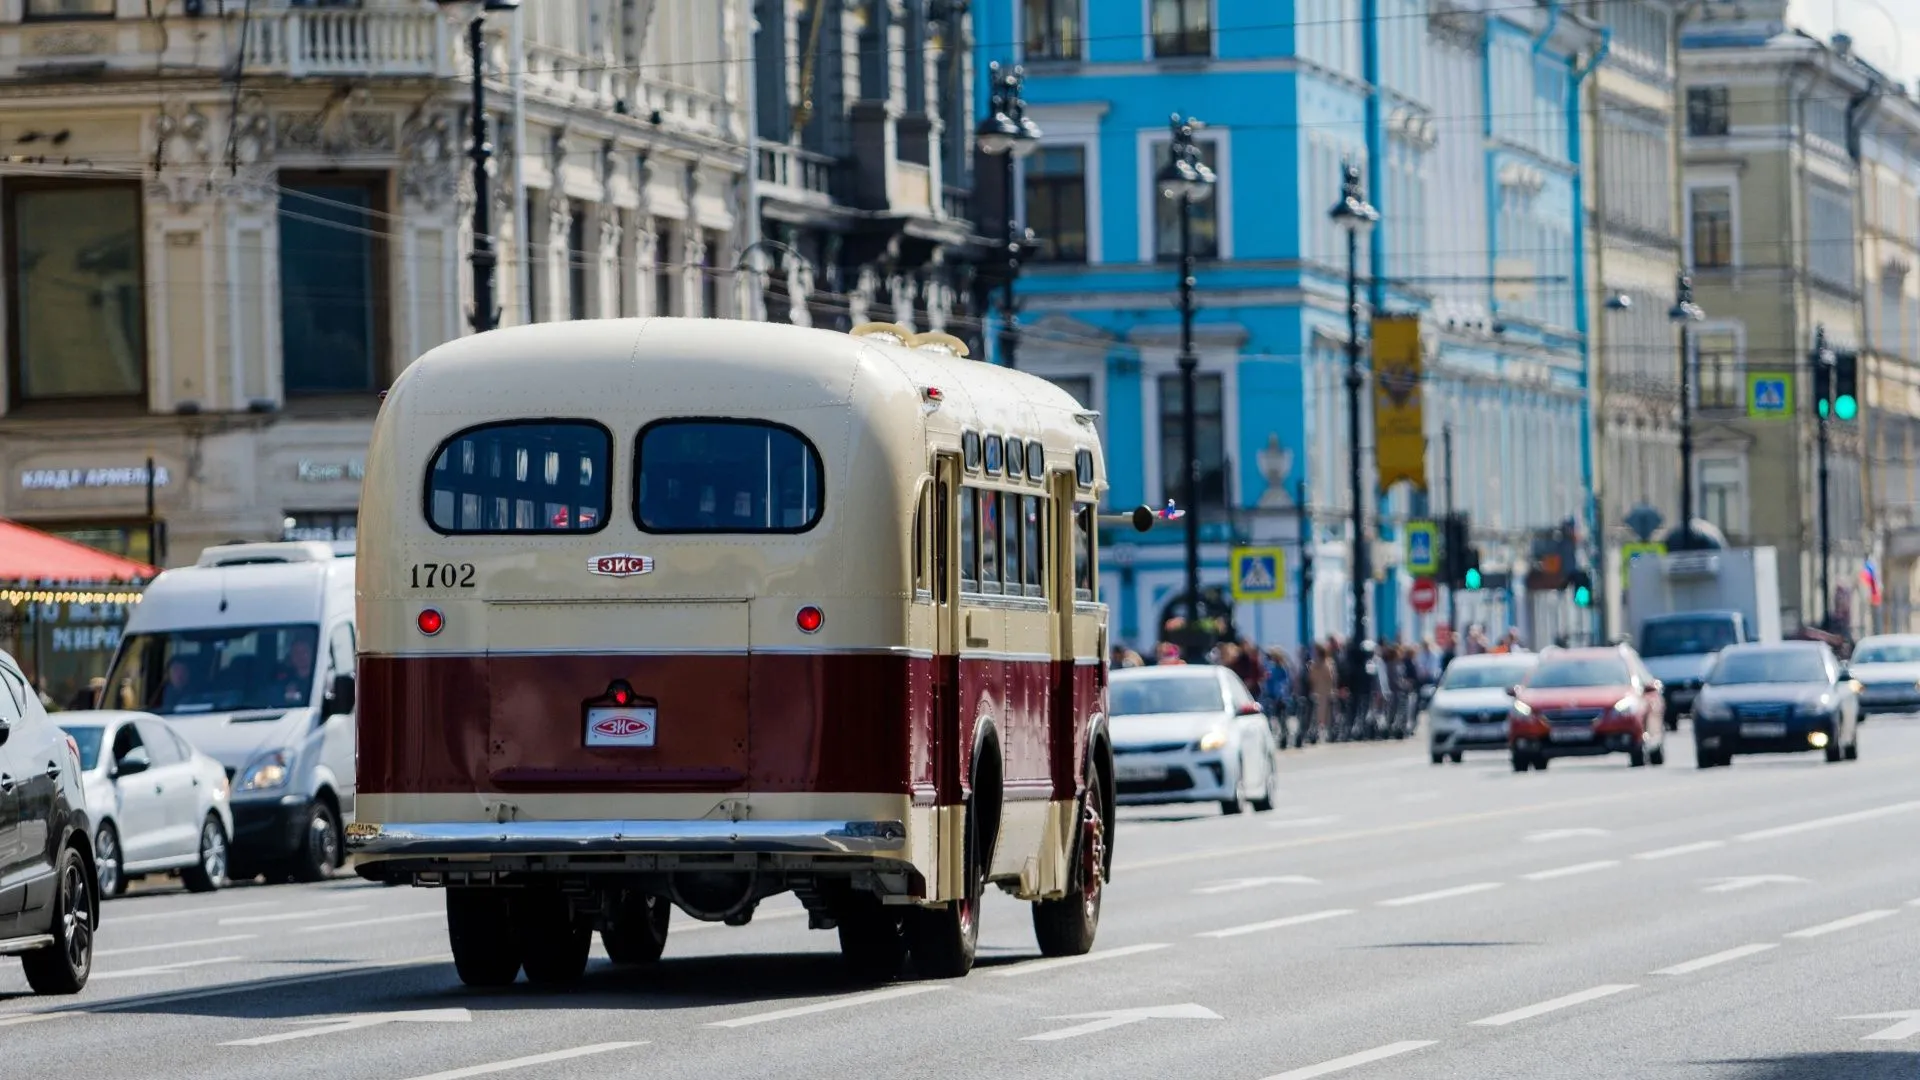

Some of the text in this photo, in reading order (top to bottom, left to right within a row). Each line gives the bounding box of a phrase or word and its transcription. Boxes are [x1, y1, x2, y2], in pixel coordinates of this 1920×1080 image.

[601, 558, 640, 572] ЗИС
[411, 563, 475, 588] 1702
[596, 719, 646, 734] ЗИС
